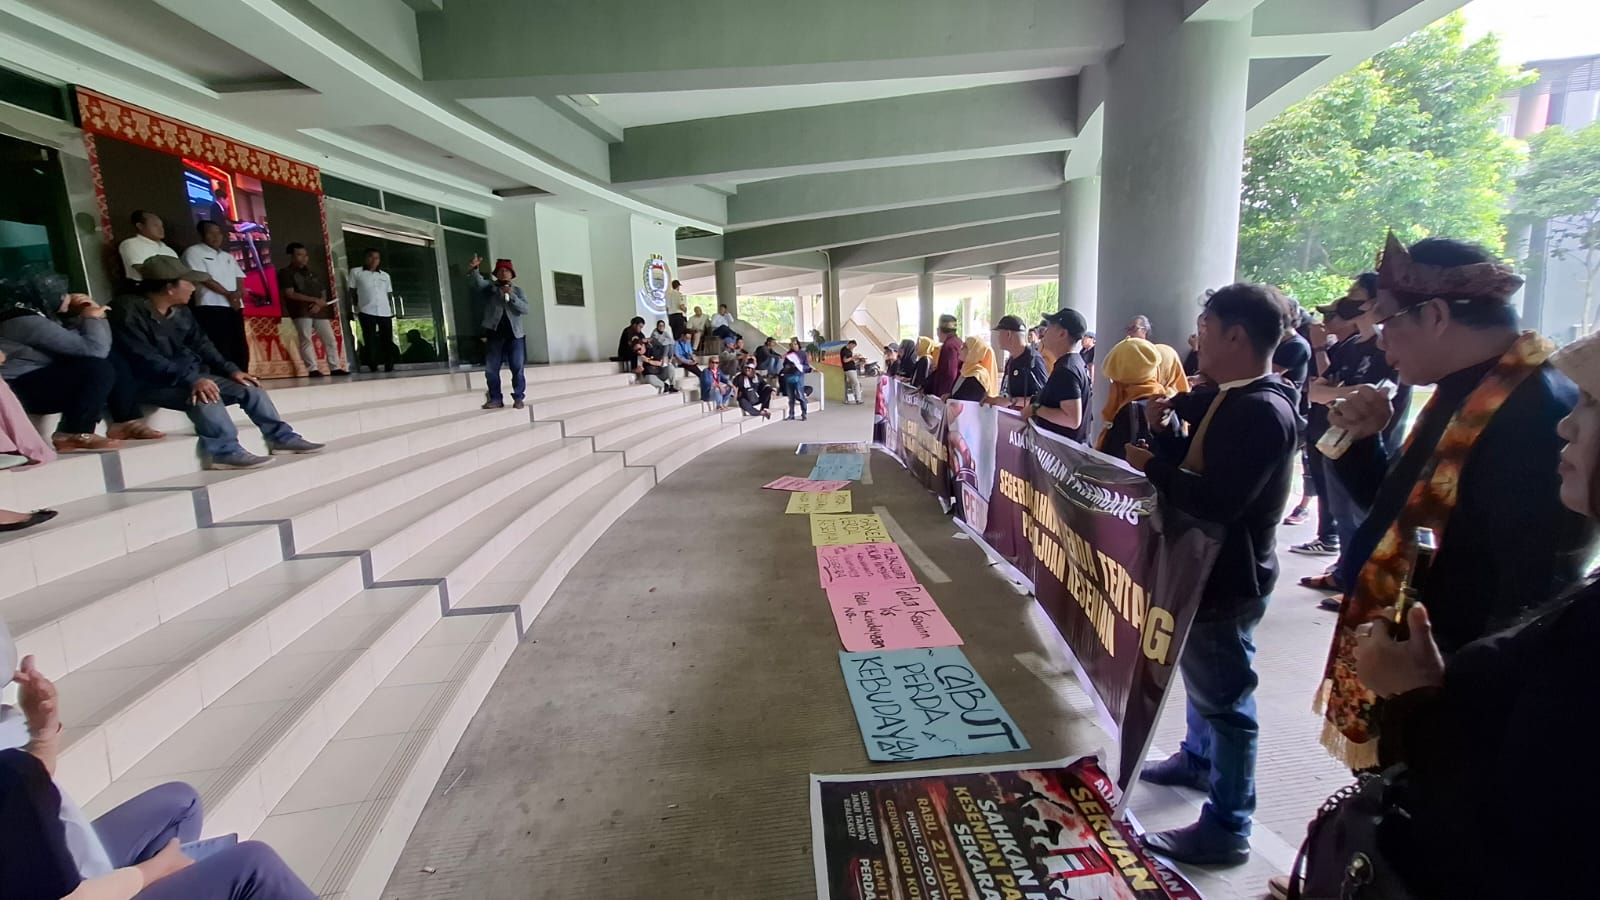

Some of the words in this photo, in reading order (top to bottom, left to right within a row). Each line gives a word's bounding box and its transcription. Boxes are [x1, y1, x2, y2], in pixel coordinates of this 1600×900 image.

[893, 662, 951, 726] PERDA
[934, 664, 1021, 750] CABUT
[860, 791, 872, 816] SUDAH
[885, 800, 904, 838] GEDUNG
[896, 841, 914, 874] DPRD
[953, 786, 1007, 867] KESENIAN
[1069, 786, 1159, 891] SERUAN
[859, 858, 877, 900] PERDA
[905, 810, 922, 843] PUKUL:
[916, 845, 937, 886] 09.00
[931, 840, 949, 859] 21
[977, 799, 1040, 886] SAHKAN
